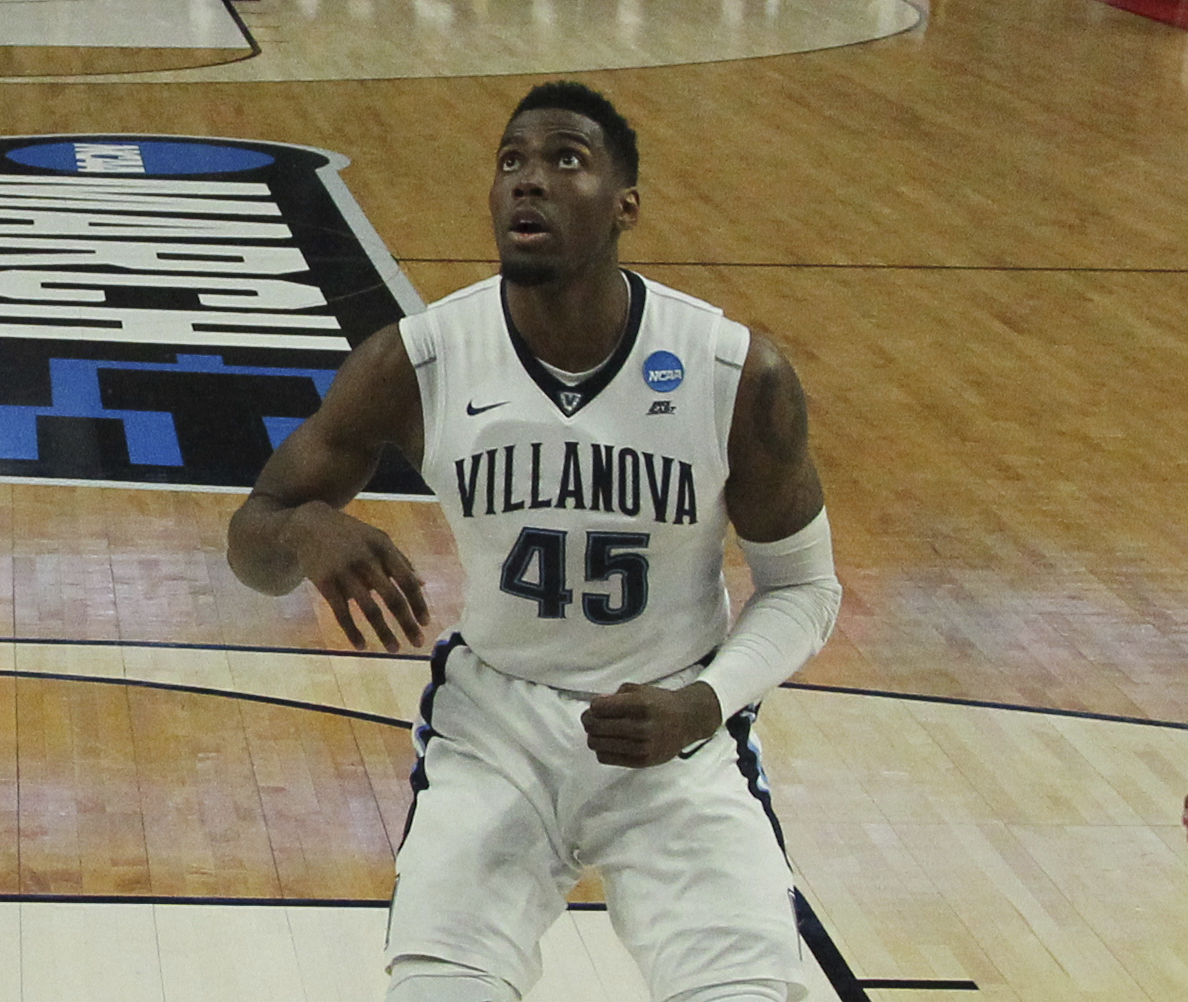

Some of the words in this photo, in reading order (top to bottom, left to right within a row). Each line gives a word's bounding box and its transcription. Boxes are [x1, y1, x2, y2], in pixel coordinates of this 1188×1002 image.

[648, 369, 682, 382] NCAA
[454, 441, 698, 525] VILLANOVA
[499, 526, 650, 626] 45
